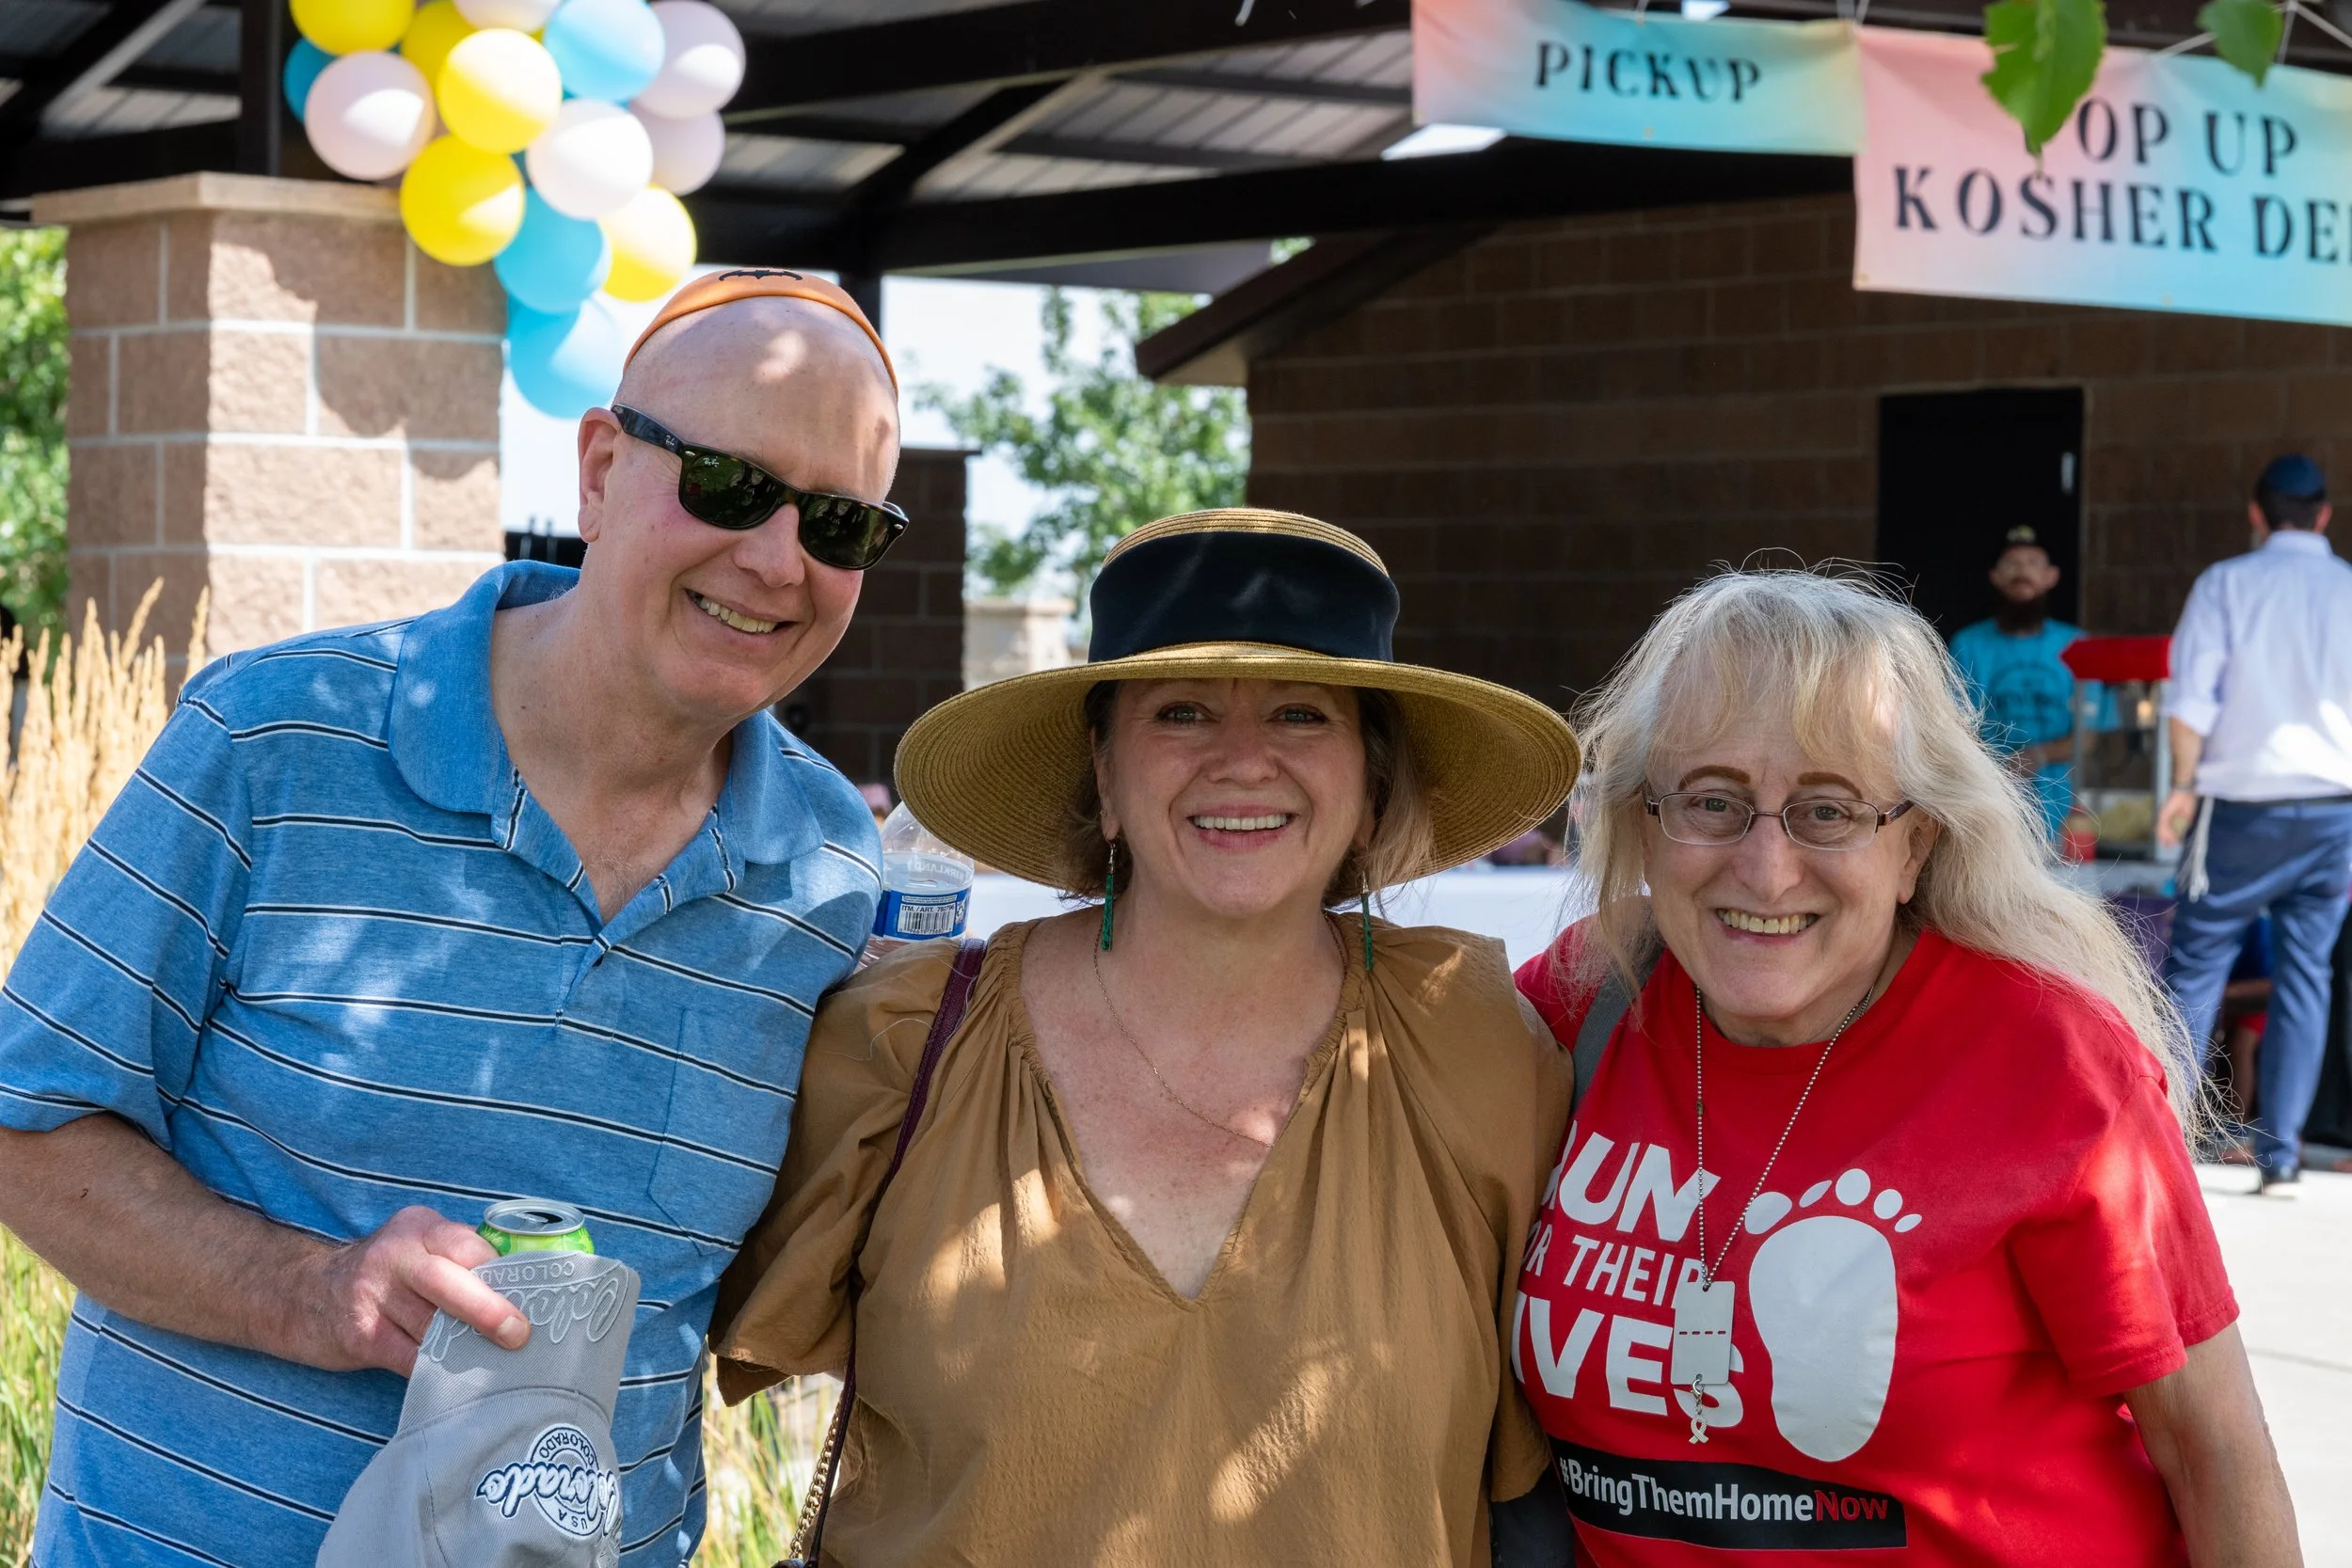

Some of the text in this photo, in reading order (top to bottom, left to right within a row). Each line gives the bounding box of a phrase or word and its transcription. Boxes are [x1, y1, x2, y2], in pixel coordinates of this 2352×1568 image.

[1535, 40, 1762, 103] PICKUP
[2024, 96, 2298, 177] OP UP
[1893, 166, 2352, 264] KOSHER DE
[471, 1261, 575, 1284] COLORAD
[1520, 1219, 1552, 1276] OR
[1511, 1289, 1744, 1428] IVES
[539, 1432, 595, 1465] COLORADO
[475, 1462, 619, 1537] Colorado
[558, 1509, 588, 1530] USA
[1560, 1457, 1888, 1522] #BringThemHomeNow
